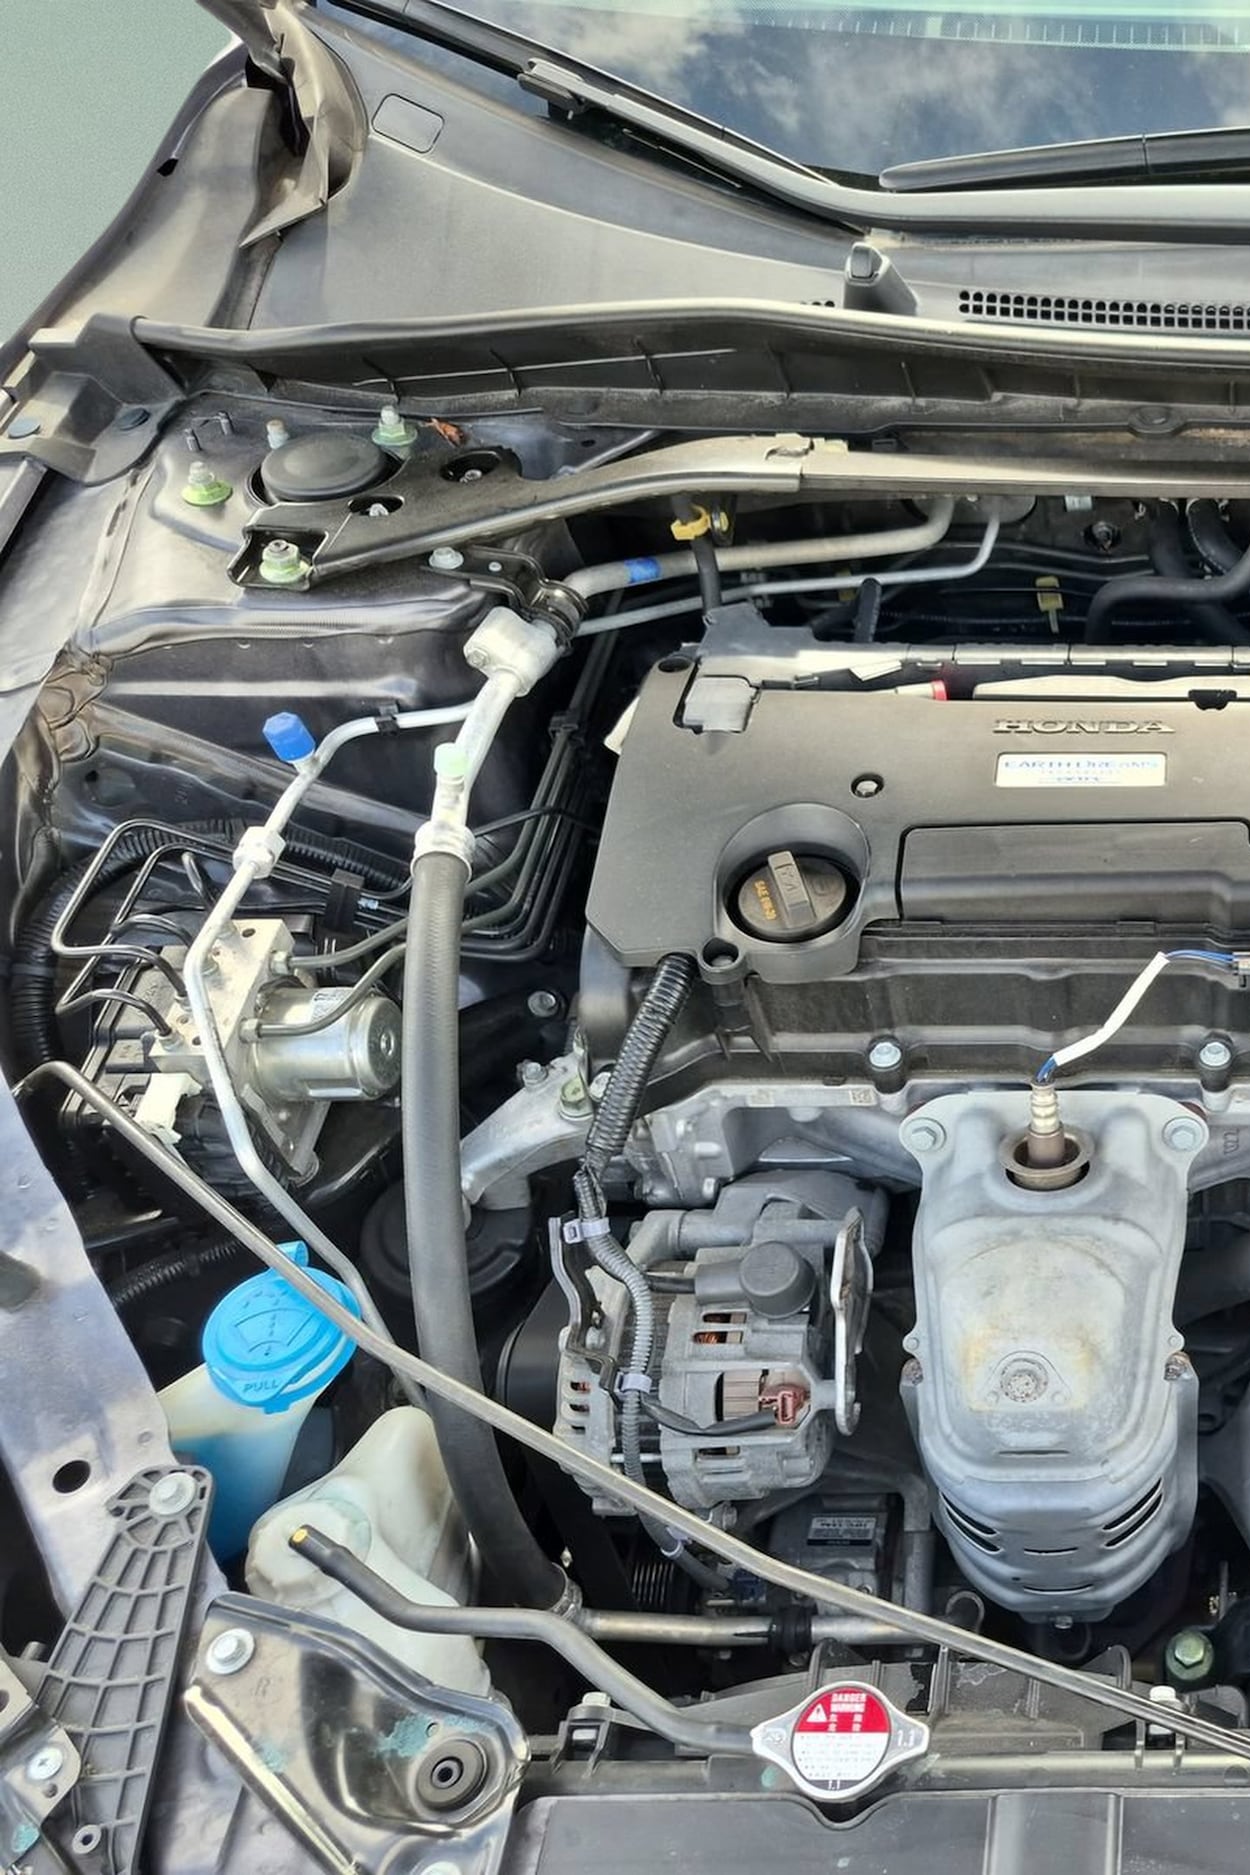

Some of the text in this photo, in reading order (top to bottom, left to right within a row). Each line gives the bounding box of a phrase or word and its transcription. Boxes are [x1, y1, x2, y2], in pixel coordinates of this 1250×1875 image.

[993, 720, 1176, 734] HONDA
[243, 1379, 279, 1393] PULL
[831, 1693, 867, 1702] DANGER
[896, 1729, 915, 1747] 1.1
[828, 1779, 840, 1790] 1.1
